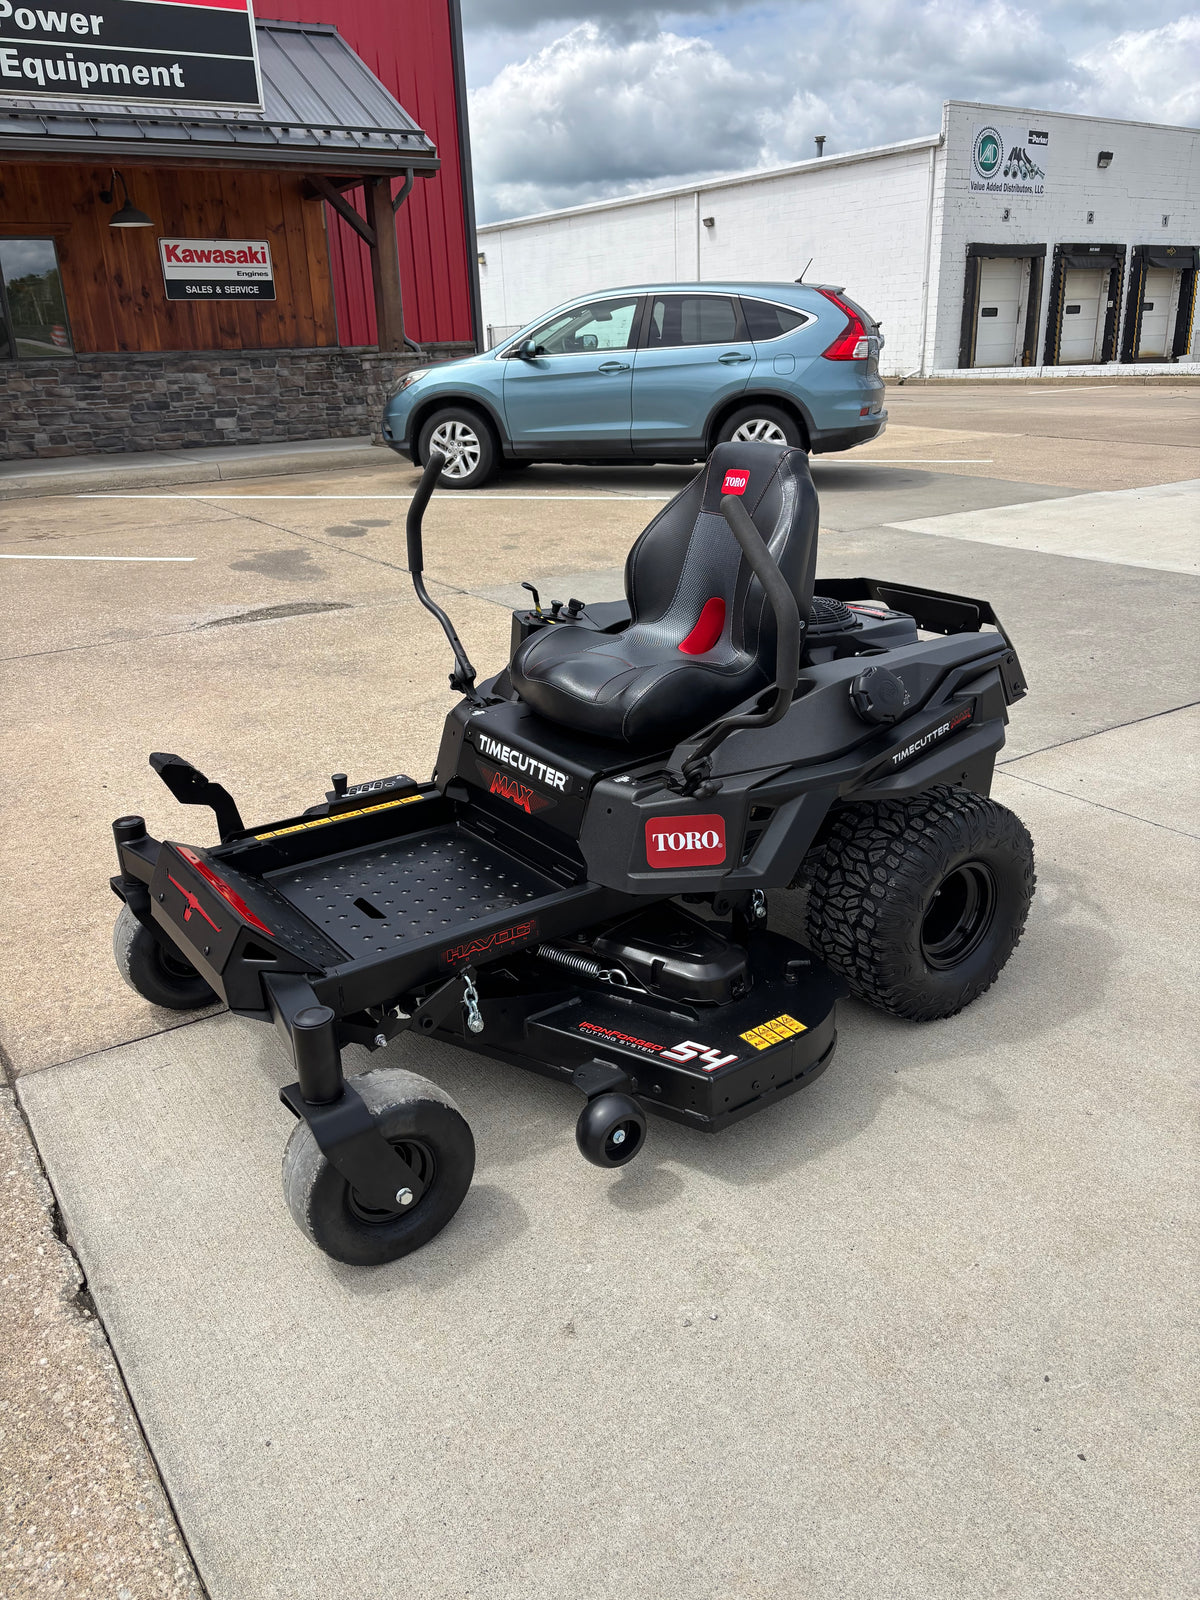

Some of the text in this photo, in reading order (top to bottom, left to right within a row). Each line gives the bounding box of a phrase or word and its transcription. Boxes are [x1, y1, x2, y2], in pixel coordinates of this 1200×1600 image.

[0, 48, 186, 89] Equipment
[970, 180, 1044, 194] Value Added Distributors, LLC
[164, 244, 267, 264] Kawasaki
[236, 270, 269, 278] Engines
[185, 285, 260, 294] SALES & SERVICE
[725, 476, 746, 488] TORO
[892, 722, 951, 764] TIMECUTTER
[480, 734, 567, 792] TIMECUTTER
[489, 772, 534, 814] MAX
[652, 830, 720, 852] TORO
[446, 921, 531, 963] HAVOC
[578, 1021, 664, 1051] IRONFORGED
[579, 1027, 656, 1054] CUTTING SYSTEM
[659, 1040, 739, 1072] 54
